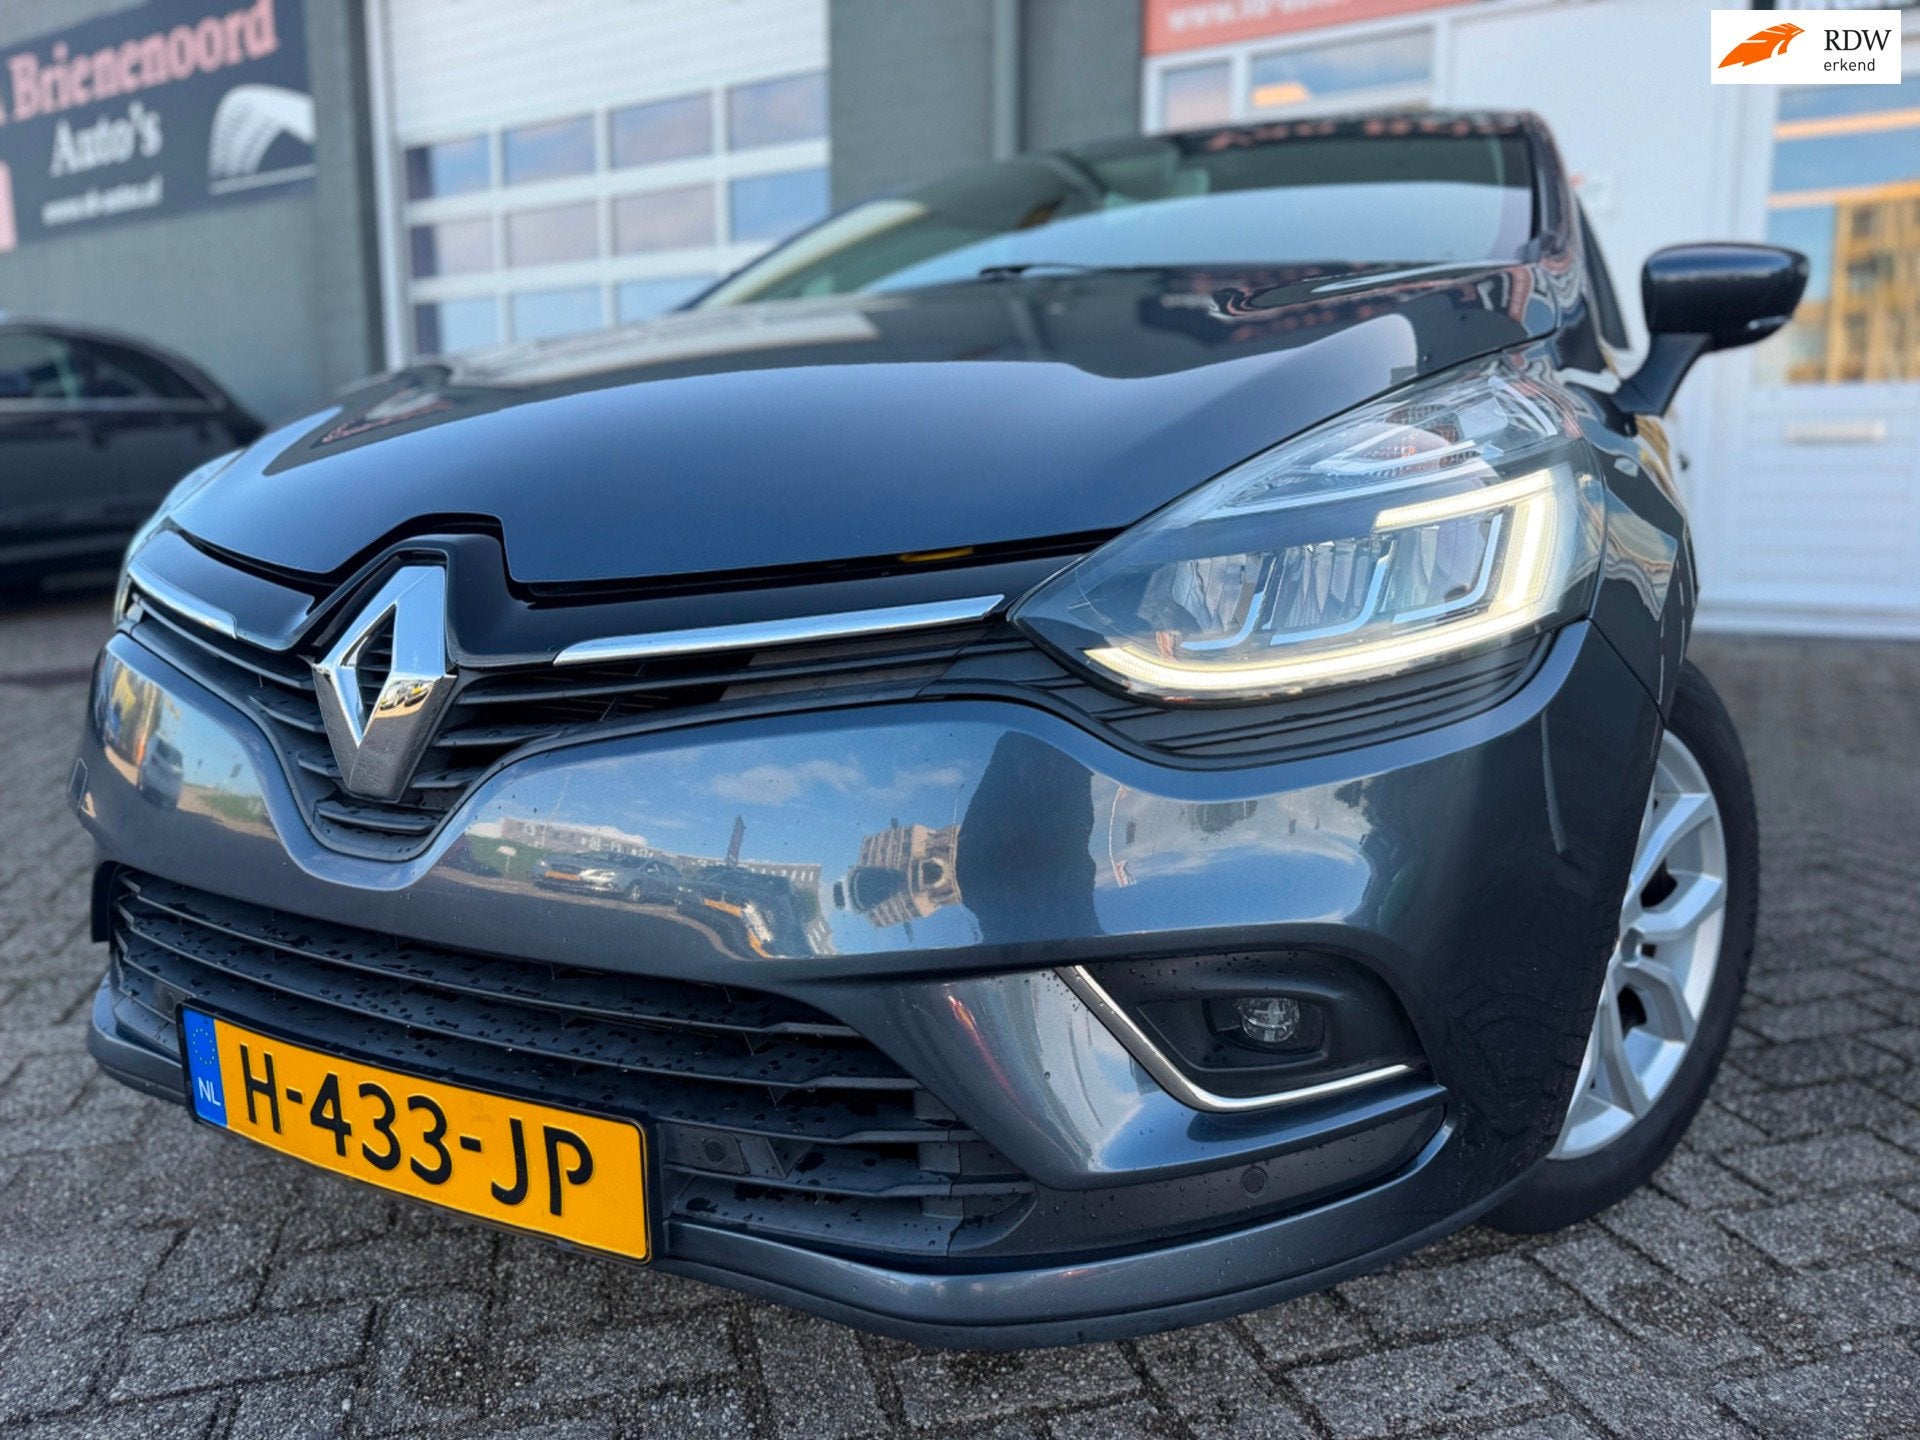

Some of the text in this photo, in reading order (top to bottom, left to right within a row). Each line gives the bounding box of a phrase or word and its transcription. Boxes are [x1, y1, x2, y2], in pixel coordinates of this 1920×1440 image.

[9, 0, 280, 121] Brienenoord
[50, 101, 162, 177] Auto's
[198, 1077, 221, 1106] NL
[239, 1042, 594, 1217] H-433-JP
